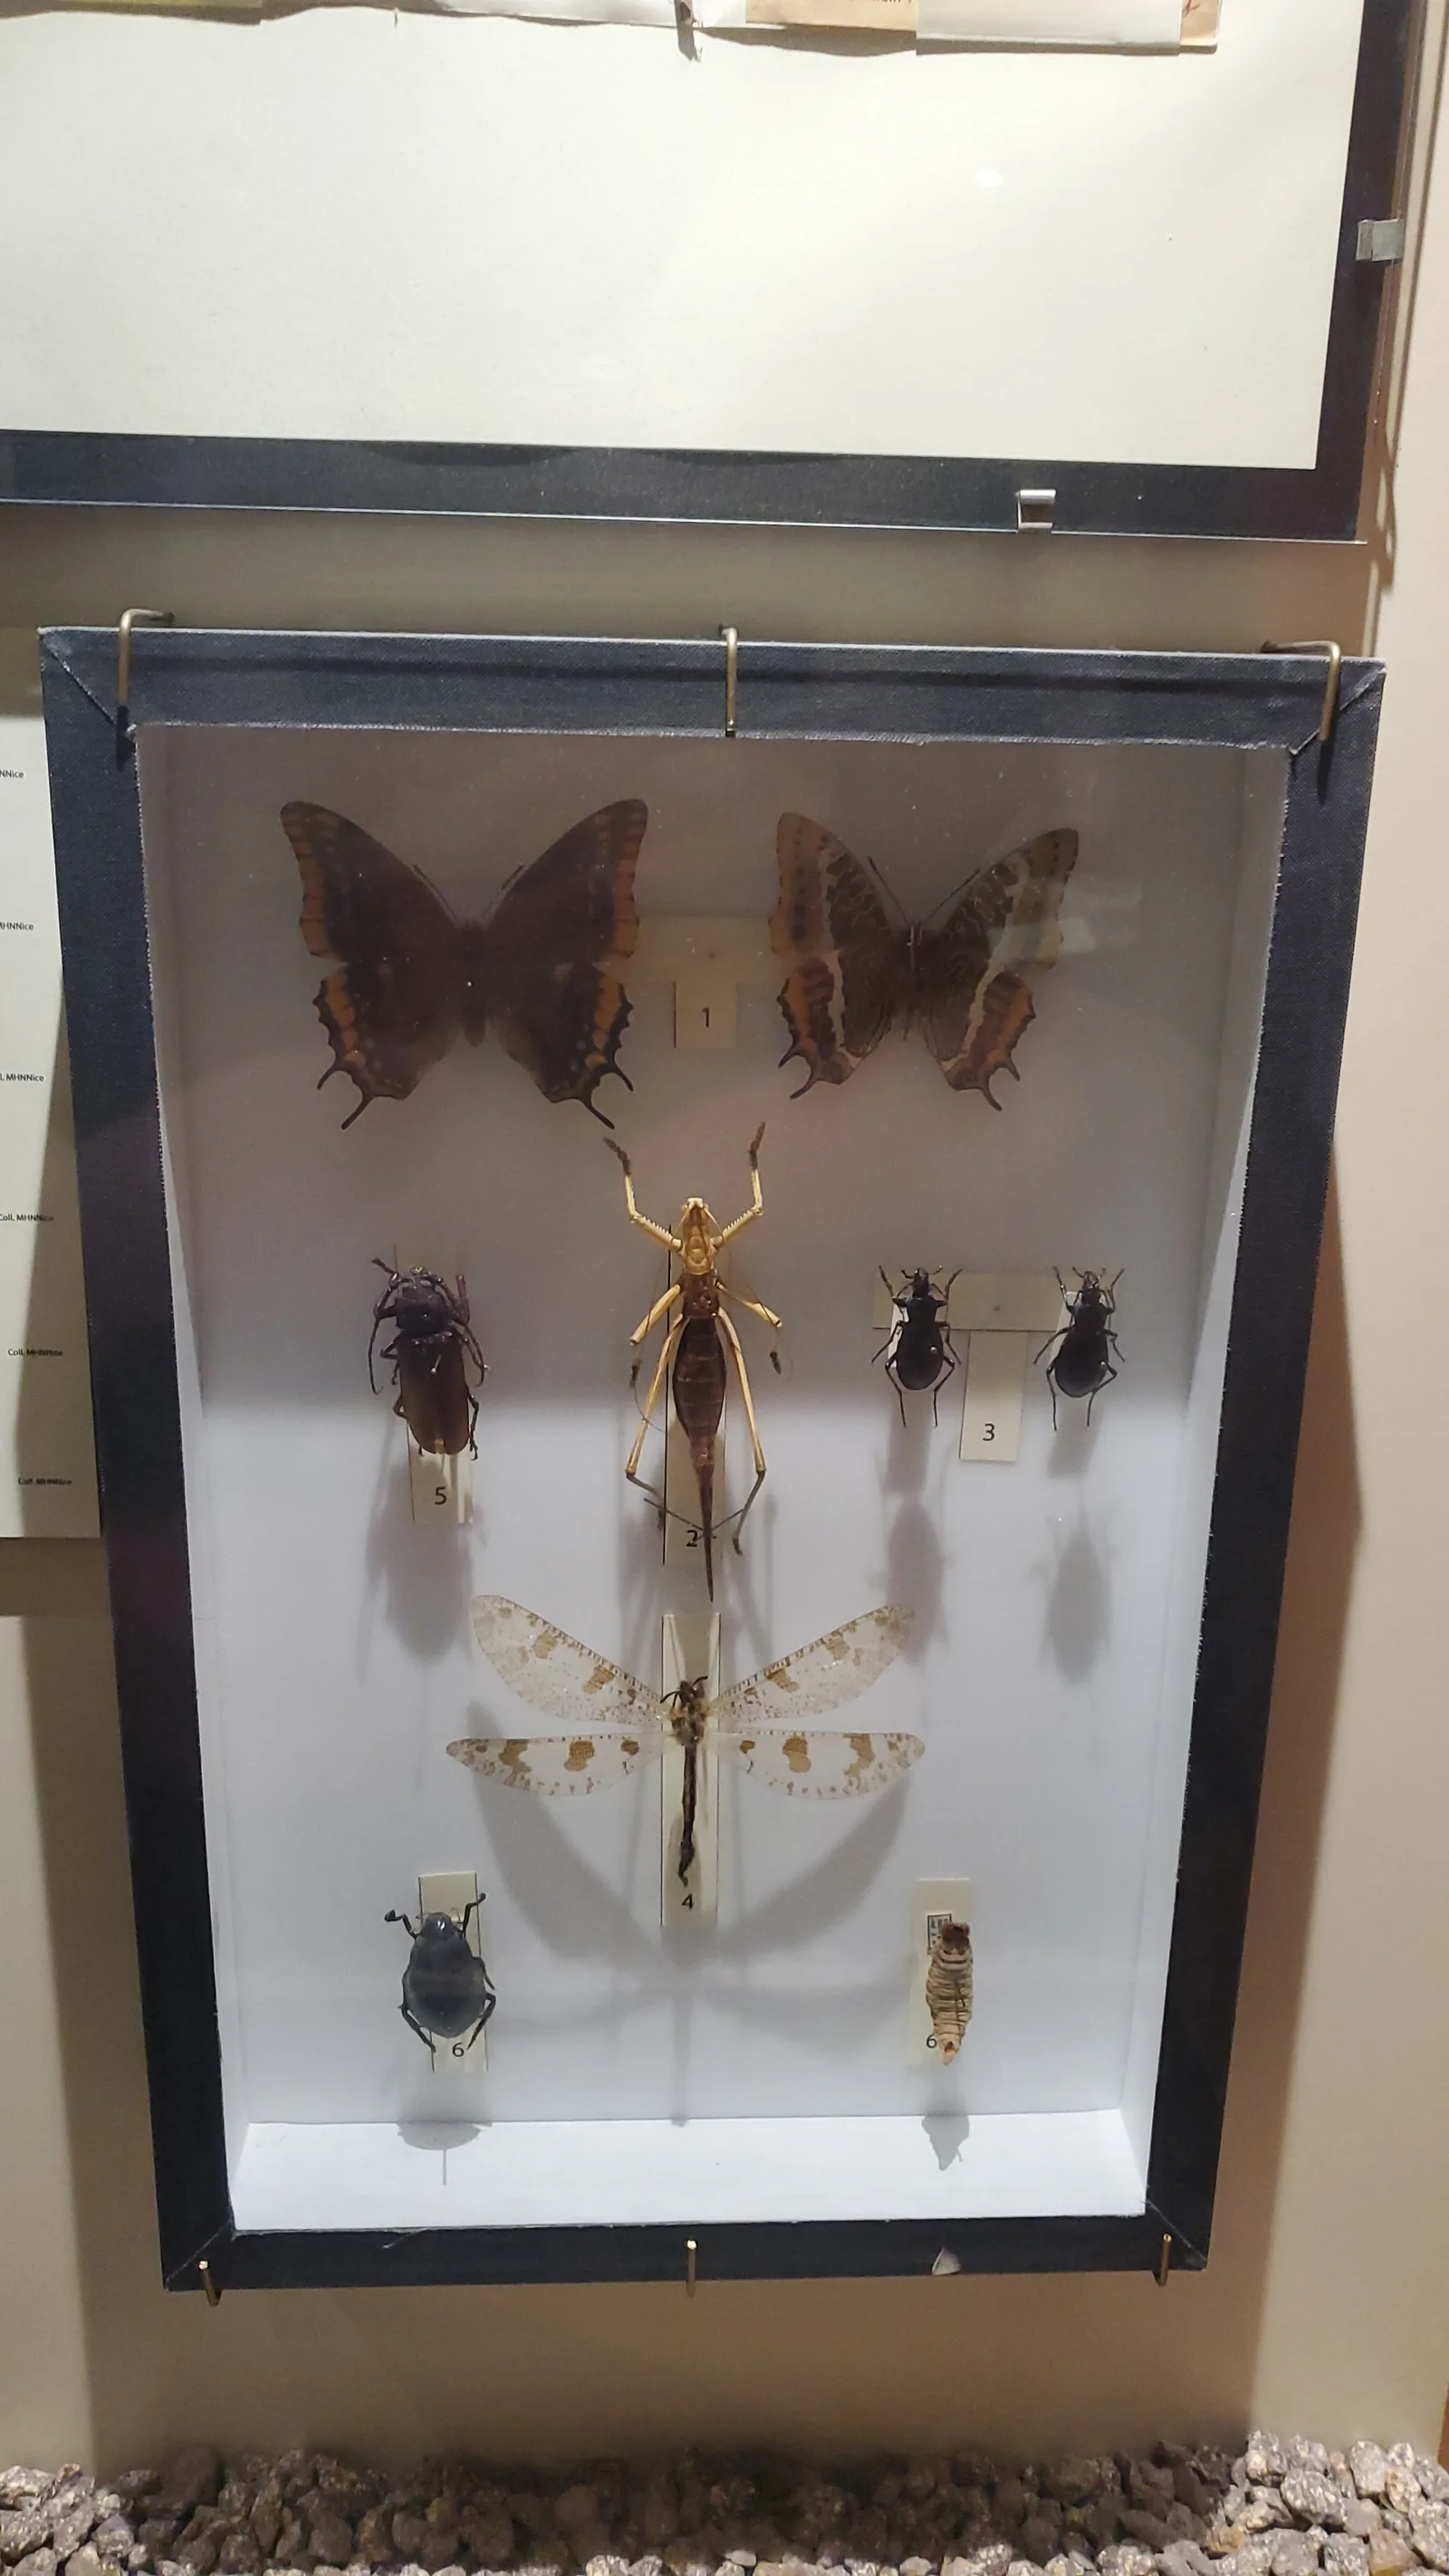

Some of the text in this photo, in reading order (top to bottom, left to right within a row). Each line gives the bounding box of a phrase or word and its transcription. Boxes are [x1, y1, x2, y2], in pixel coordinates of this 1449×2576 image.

[702, 1007, 710, 1028] 1
[6, 1073, 44, 1082] MHNNice
[983, 1423, 994, 1441] 3
[434, 1486, 446, 1504] 5
[686, 1530, 698, 1547] 2
[681, 1893, 694, 1910] 4
[452, 2042, 465, 2057] 6
[926, 2033, 936, 2049] 6
